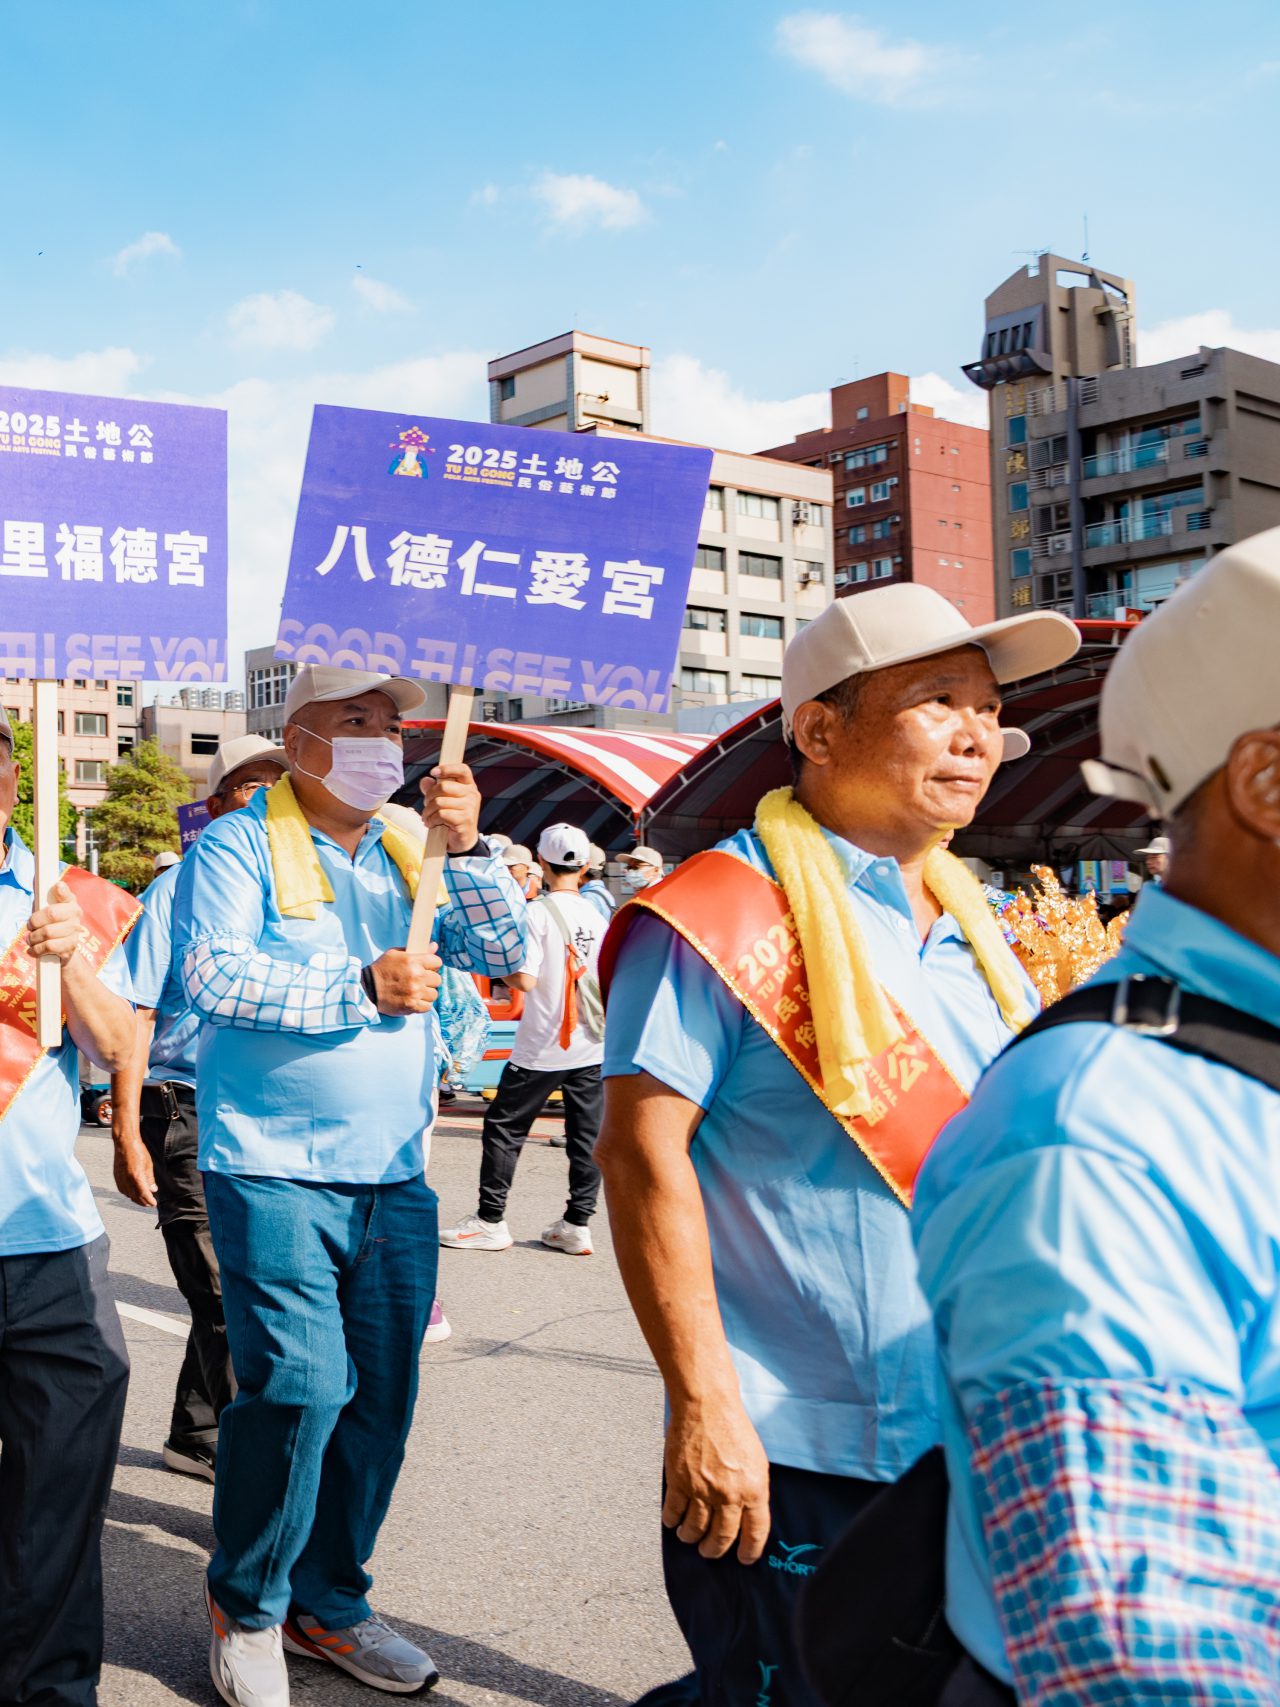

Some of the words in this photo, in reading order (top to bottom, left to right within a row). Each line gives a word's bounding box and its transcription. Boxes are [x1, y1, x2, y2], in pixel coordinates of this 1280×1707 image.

[12, 435, 26, 446] DI
[28, 437, 62, 449] GONG
[445, 464, 461, 474] TU
[463, 466, 478, 477] DI
[480, 468, 516, 481] GONG
[517, 477, 618, 499] 民俗藝術節
[315, 524, 666, 620] 八德仁愛宮
